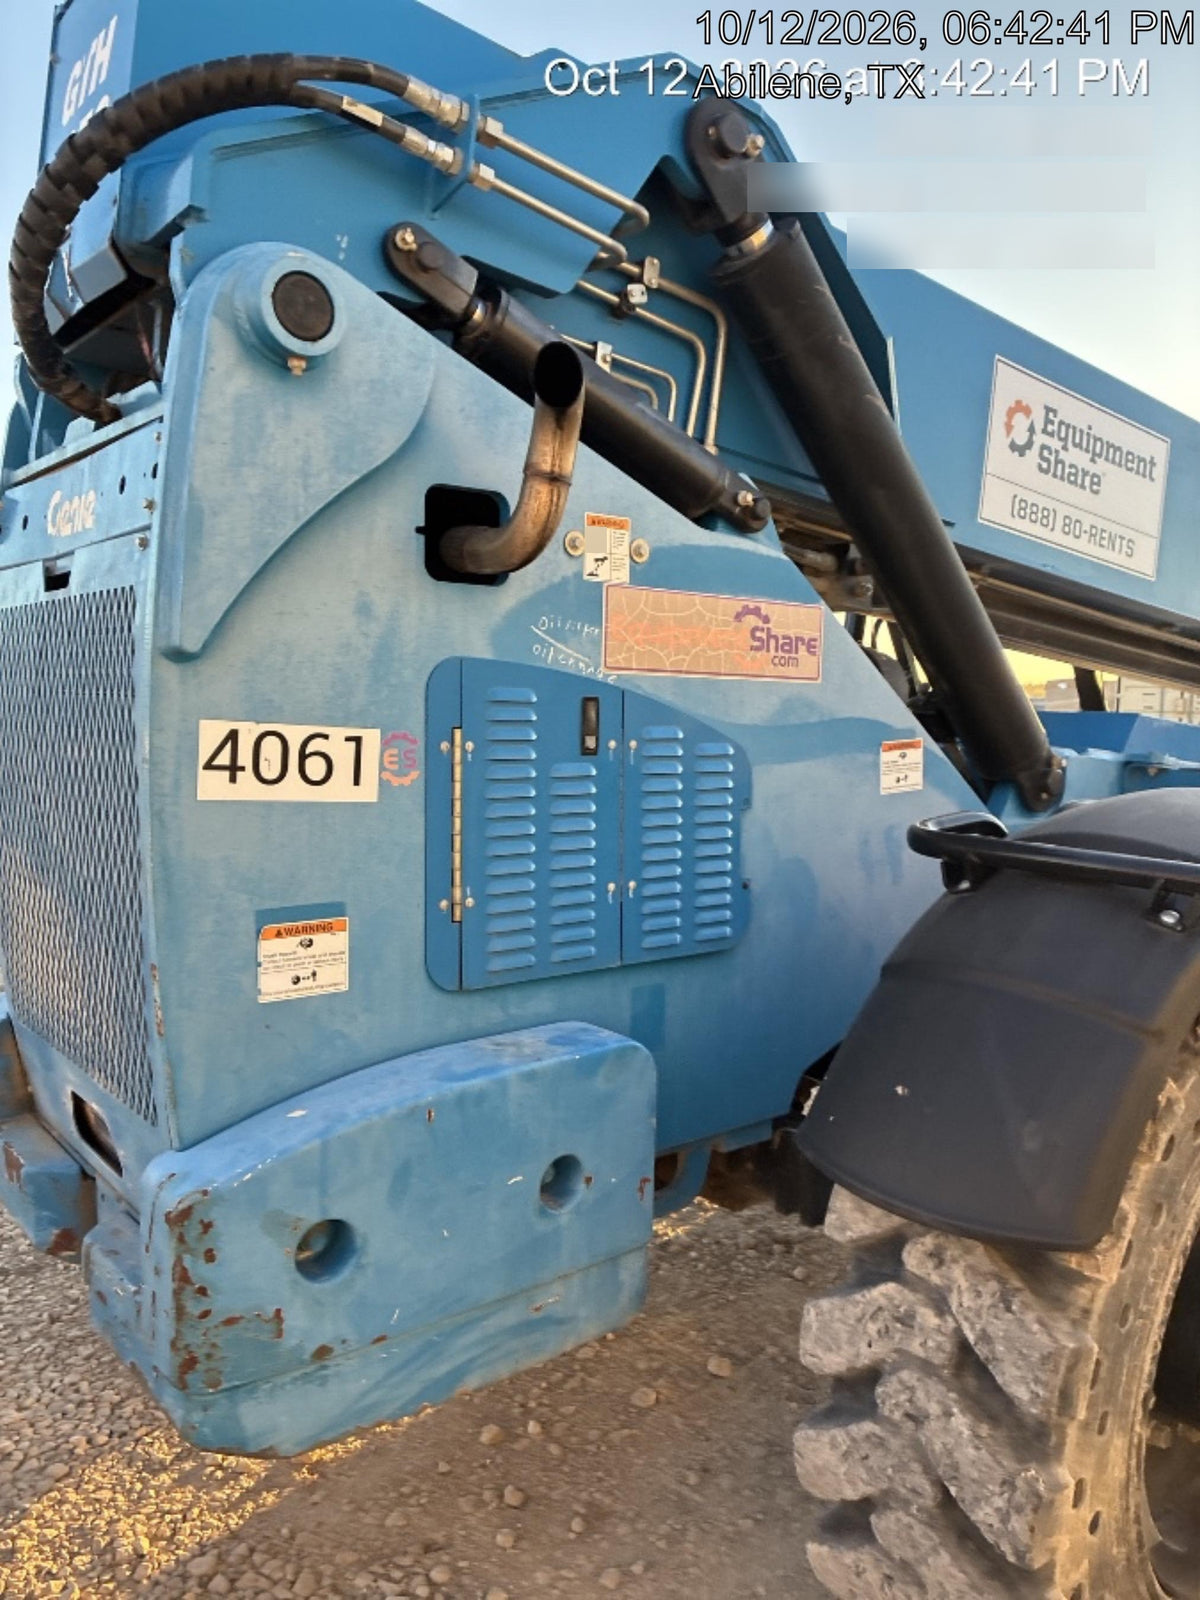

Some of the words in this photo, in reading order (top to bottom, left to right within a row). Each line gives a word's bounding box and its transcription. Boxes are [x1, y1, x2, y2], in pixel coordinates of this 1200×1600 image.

[1037, 443, 1101, 494] Share
[1041, 404, 1157, 482] Equipment
[1010, 494, 1057, 532] (888)
[1061, 515, 1136, 558] 80-RENTS
[750, 625, 819, 656] Share
[202, 728, 364, 786] 4061
[283, 922, 334, 936] WARNING
